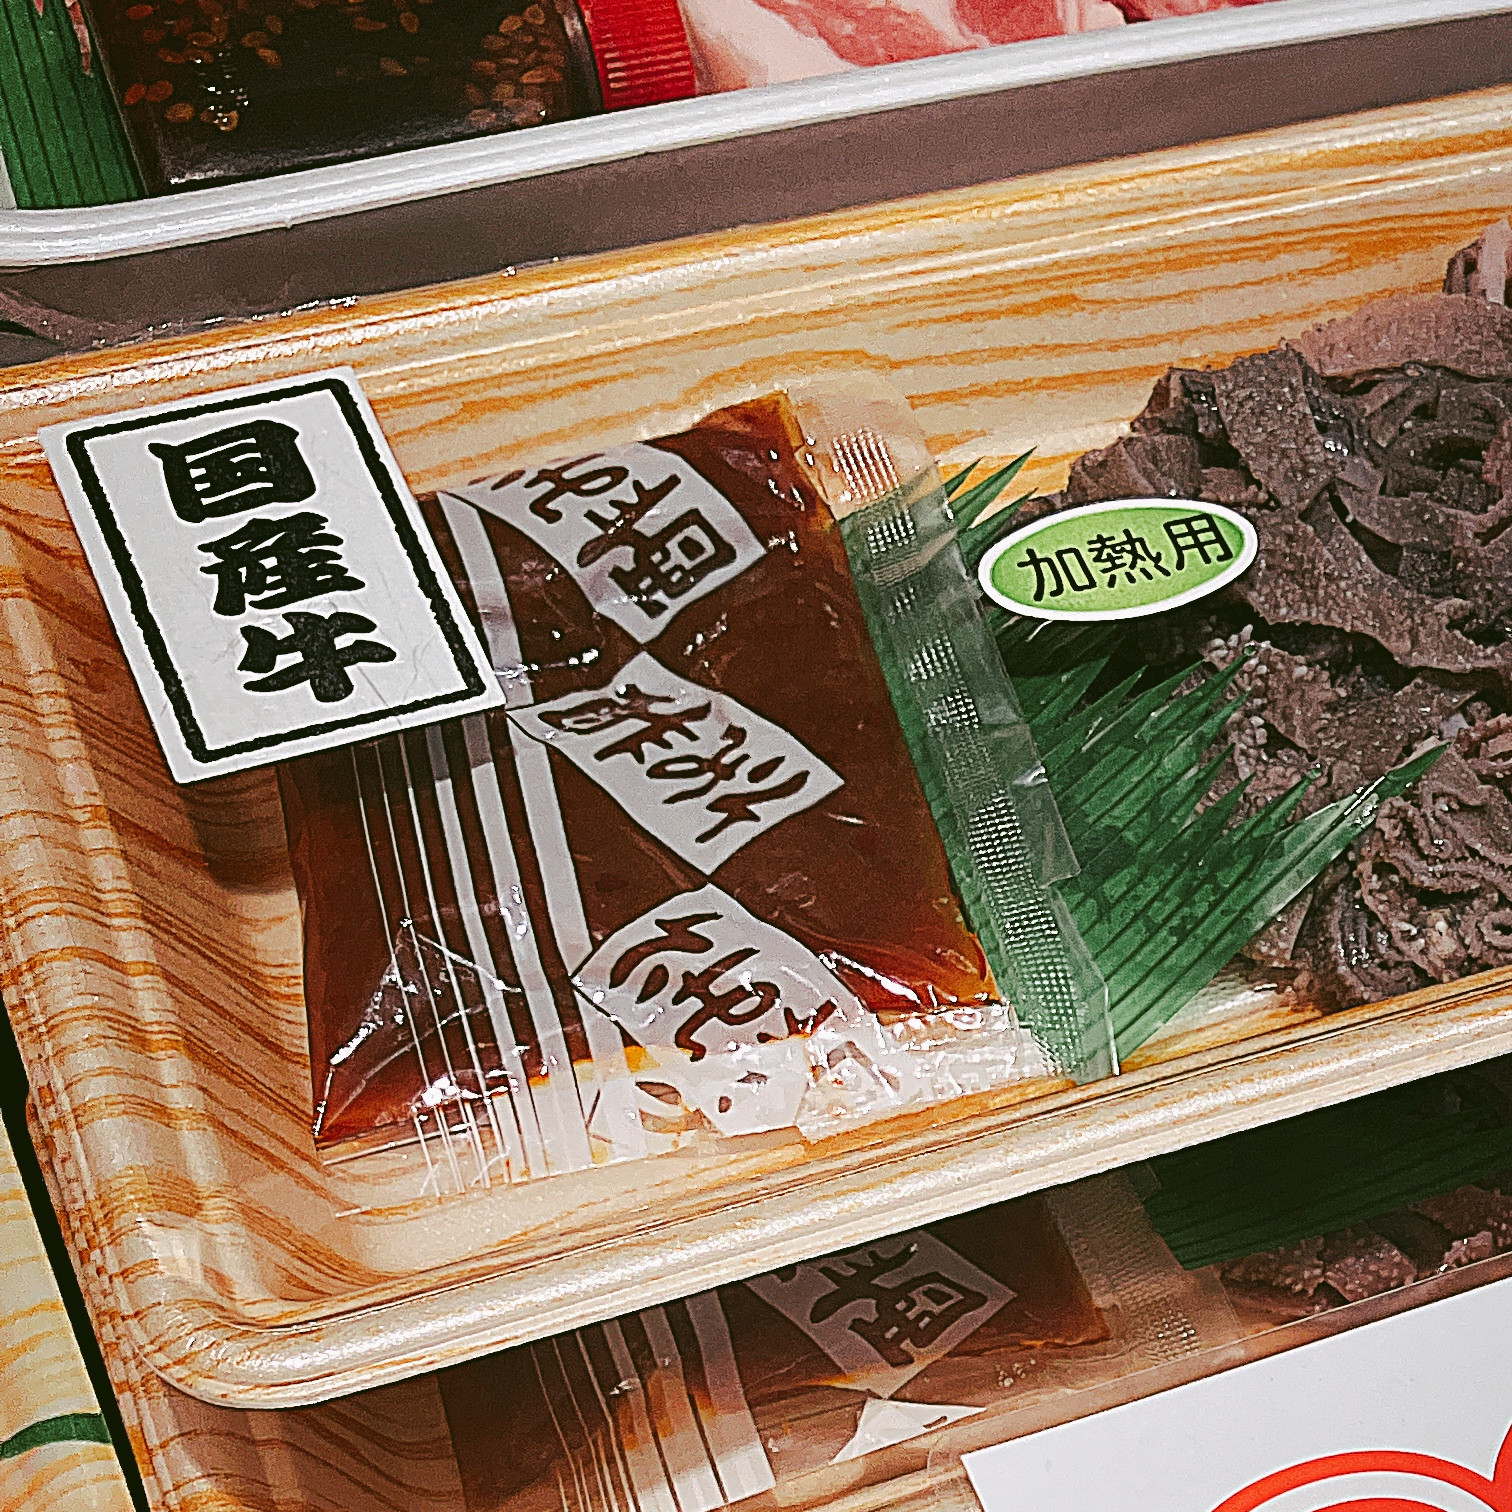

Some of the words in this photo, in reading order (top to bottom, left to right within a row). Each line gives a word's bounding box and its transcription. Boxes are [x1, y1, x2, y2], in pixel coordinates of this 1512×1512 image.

[149, 418, 398, 703] 国産牛
[1017, 513, 1233, 601] 加熱用
[537, 684, 810, 843] 酢みそ
